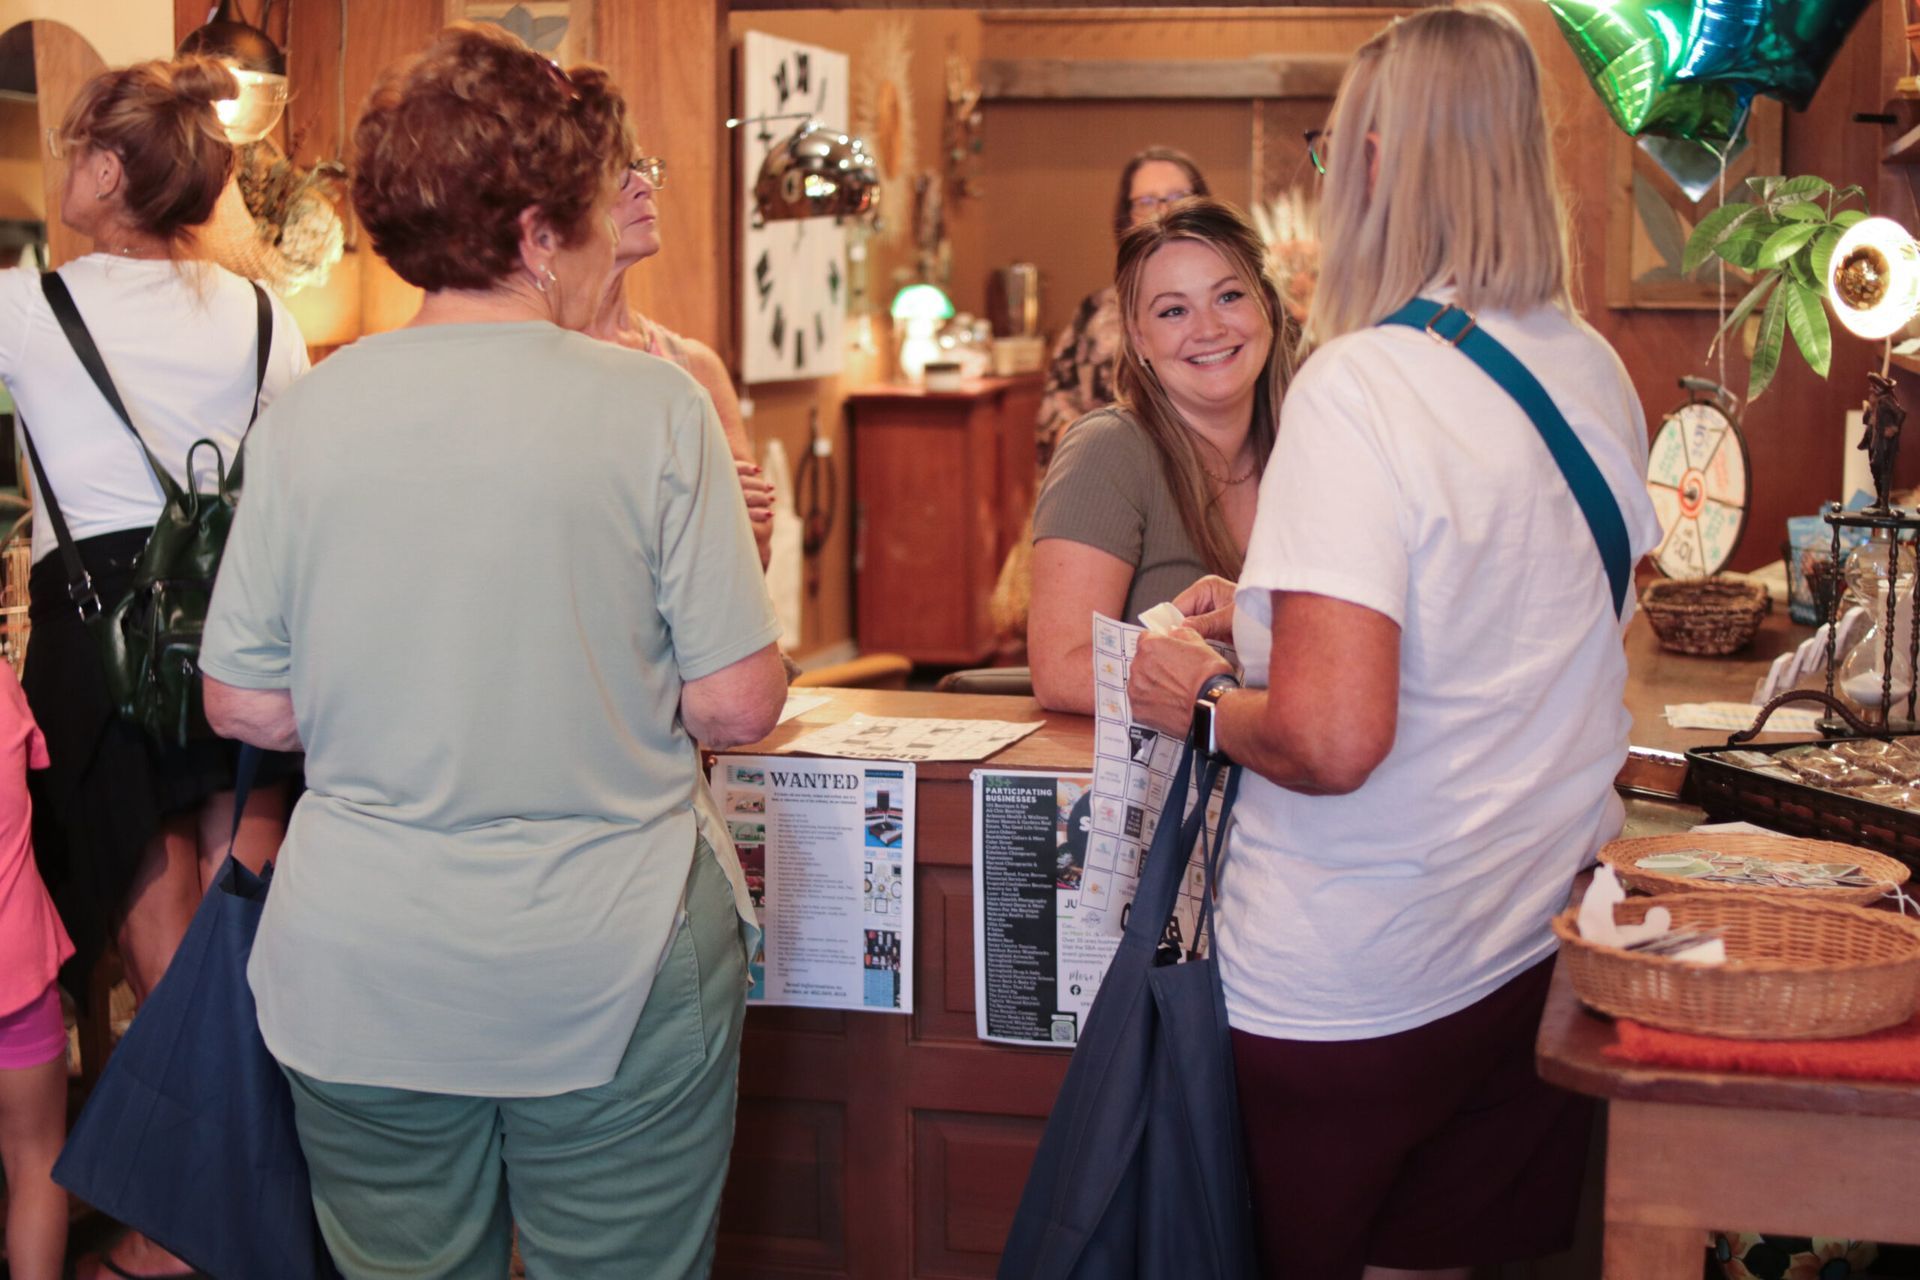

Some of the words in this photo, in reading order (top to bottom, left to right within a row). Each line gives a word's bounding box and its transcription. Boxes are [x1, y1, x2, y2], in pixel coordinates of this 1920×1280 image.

[770, 772, 859, 790] WANTED
[986, 787, 1053, 796] PARTICIPATING
[986, 795, 1037, 803] BUSINESSES
[1064, 899, 1078, 909] JU
